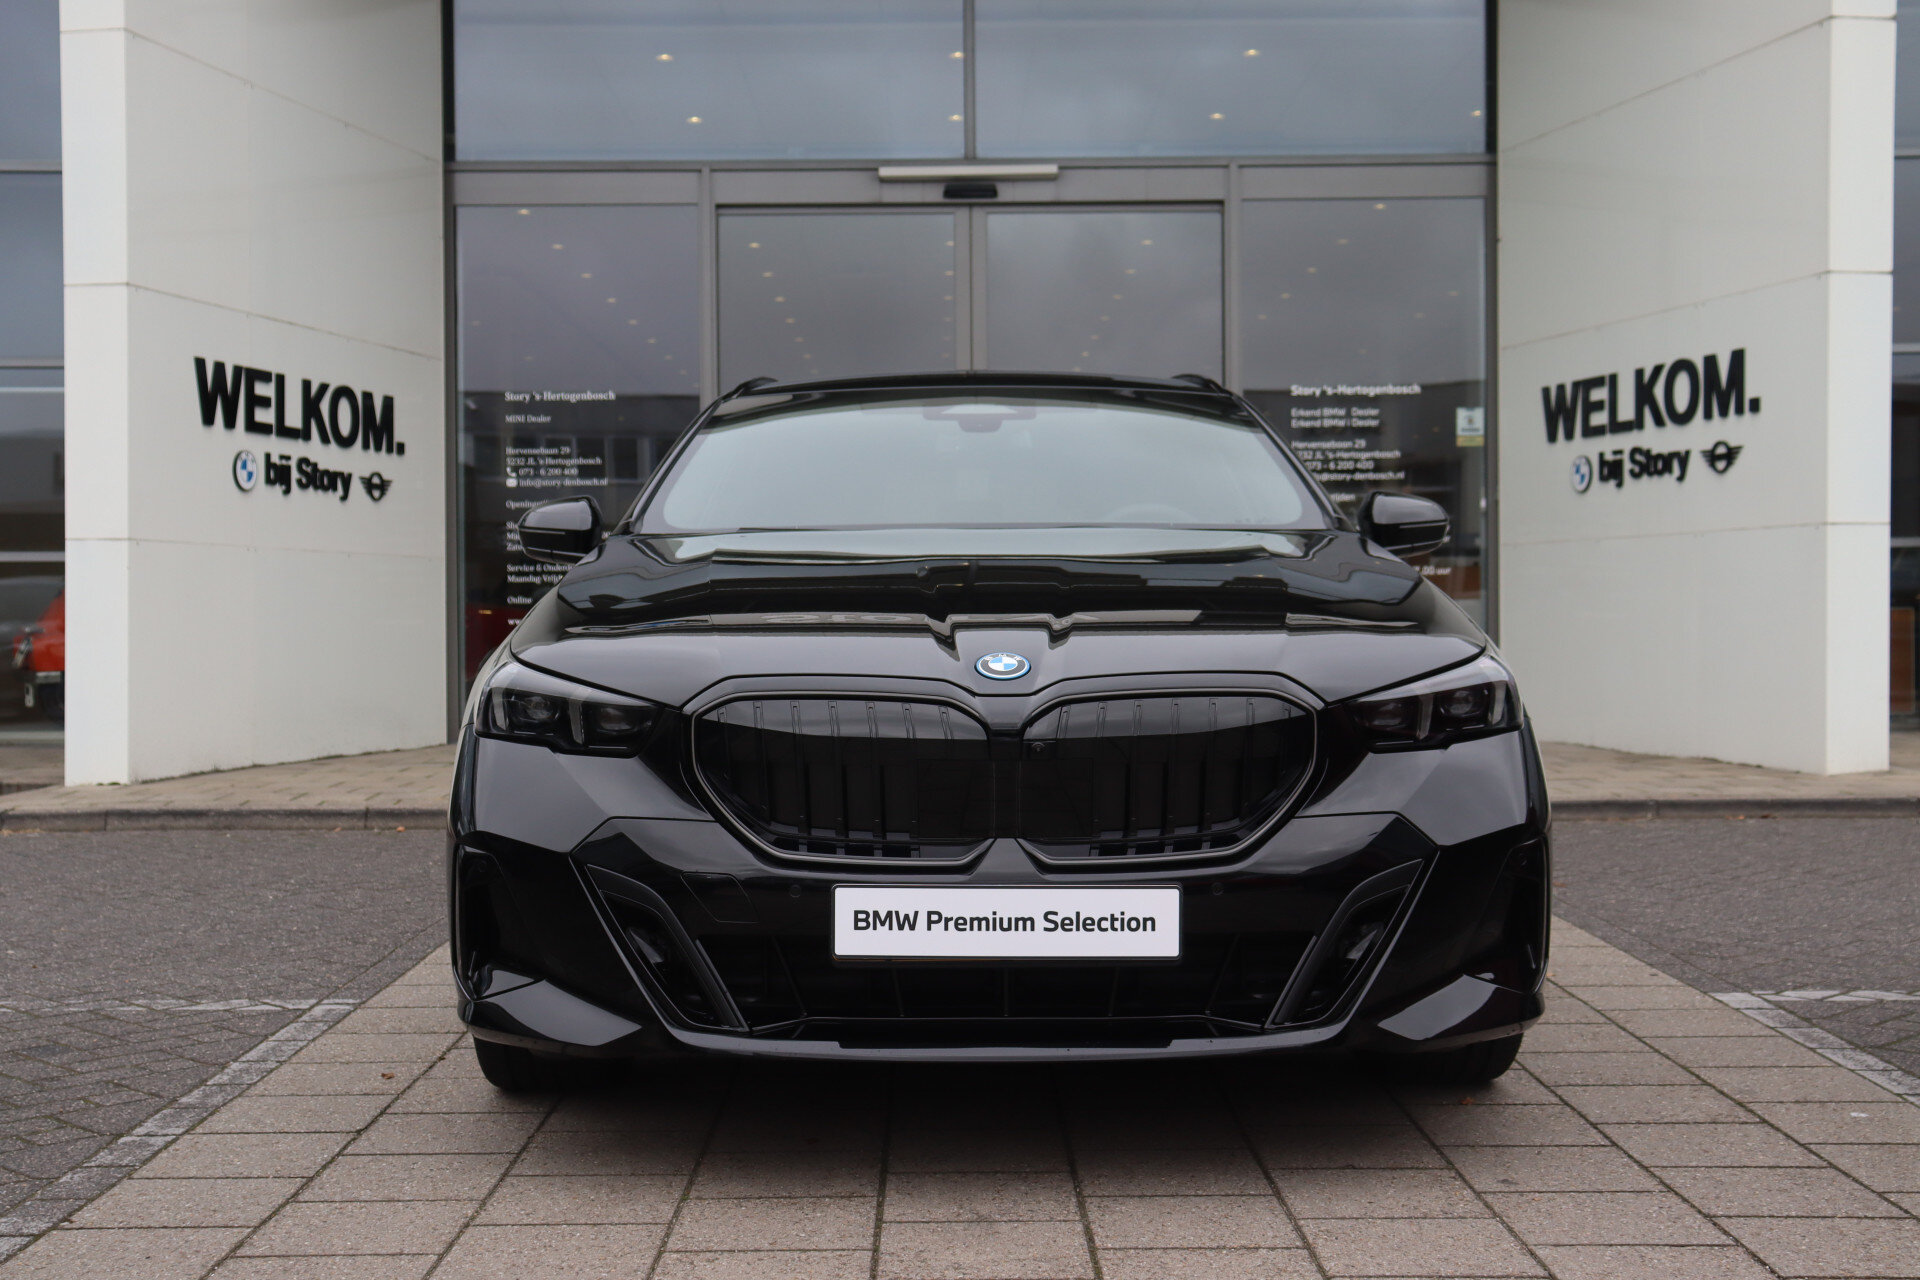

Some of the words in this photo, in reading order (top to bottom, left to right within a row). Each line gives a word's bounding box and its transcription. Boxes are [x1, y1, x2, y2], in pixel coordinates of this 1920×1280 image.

[194, 356, 405, 456] WELKOM.
[504, 391, 531, 404] Story
[533, 390, 616, 403] 's-Hertogenbosch
[1290, 385, 1321, 398] Story
[1323, 384, 1421, 396] 's-Hertogenbosch
[1542, 347, 1761, 444] WELKOM.
[296, 457, 352, 502] Story
[1629, 447, 1691, 482] Story
[853, 910, 919, 931] BMW
[927, 911, 1035, 932] Premium
[1043, 911, 1157, 932] Selection
